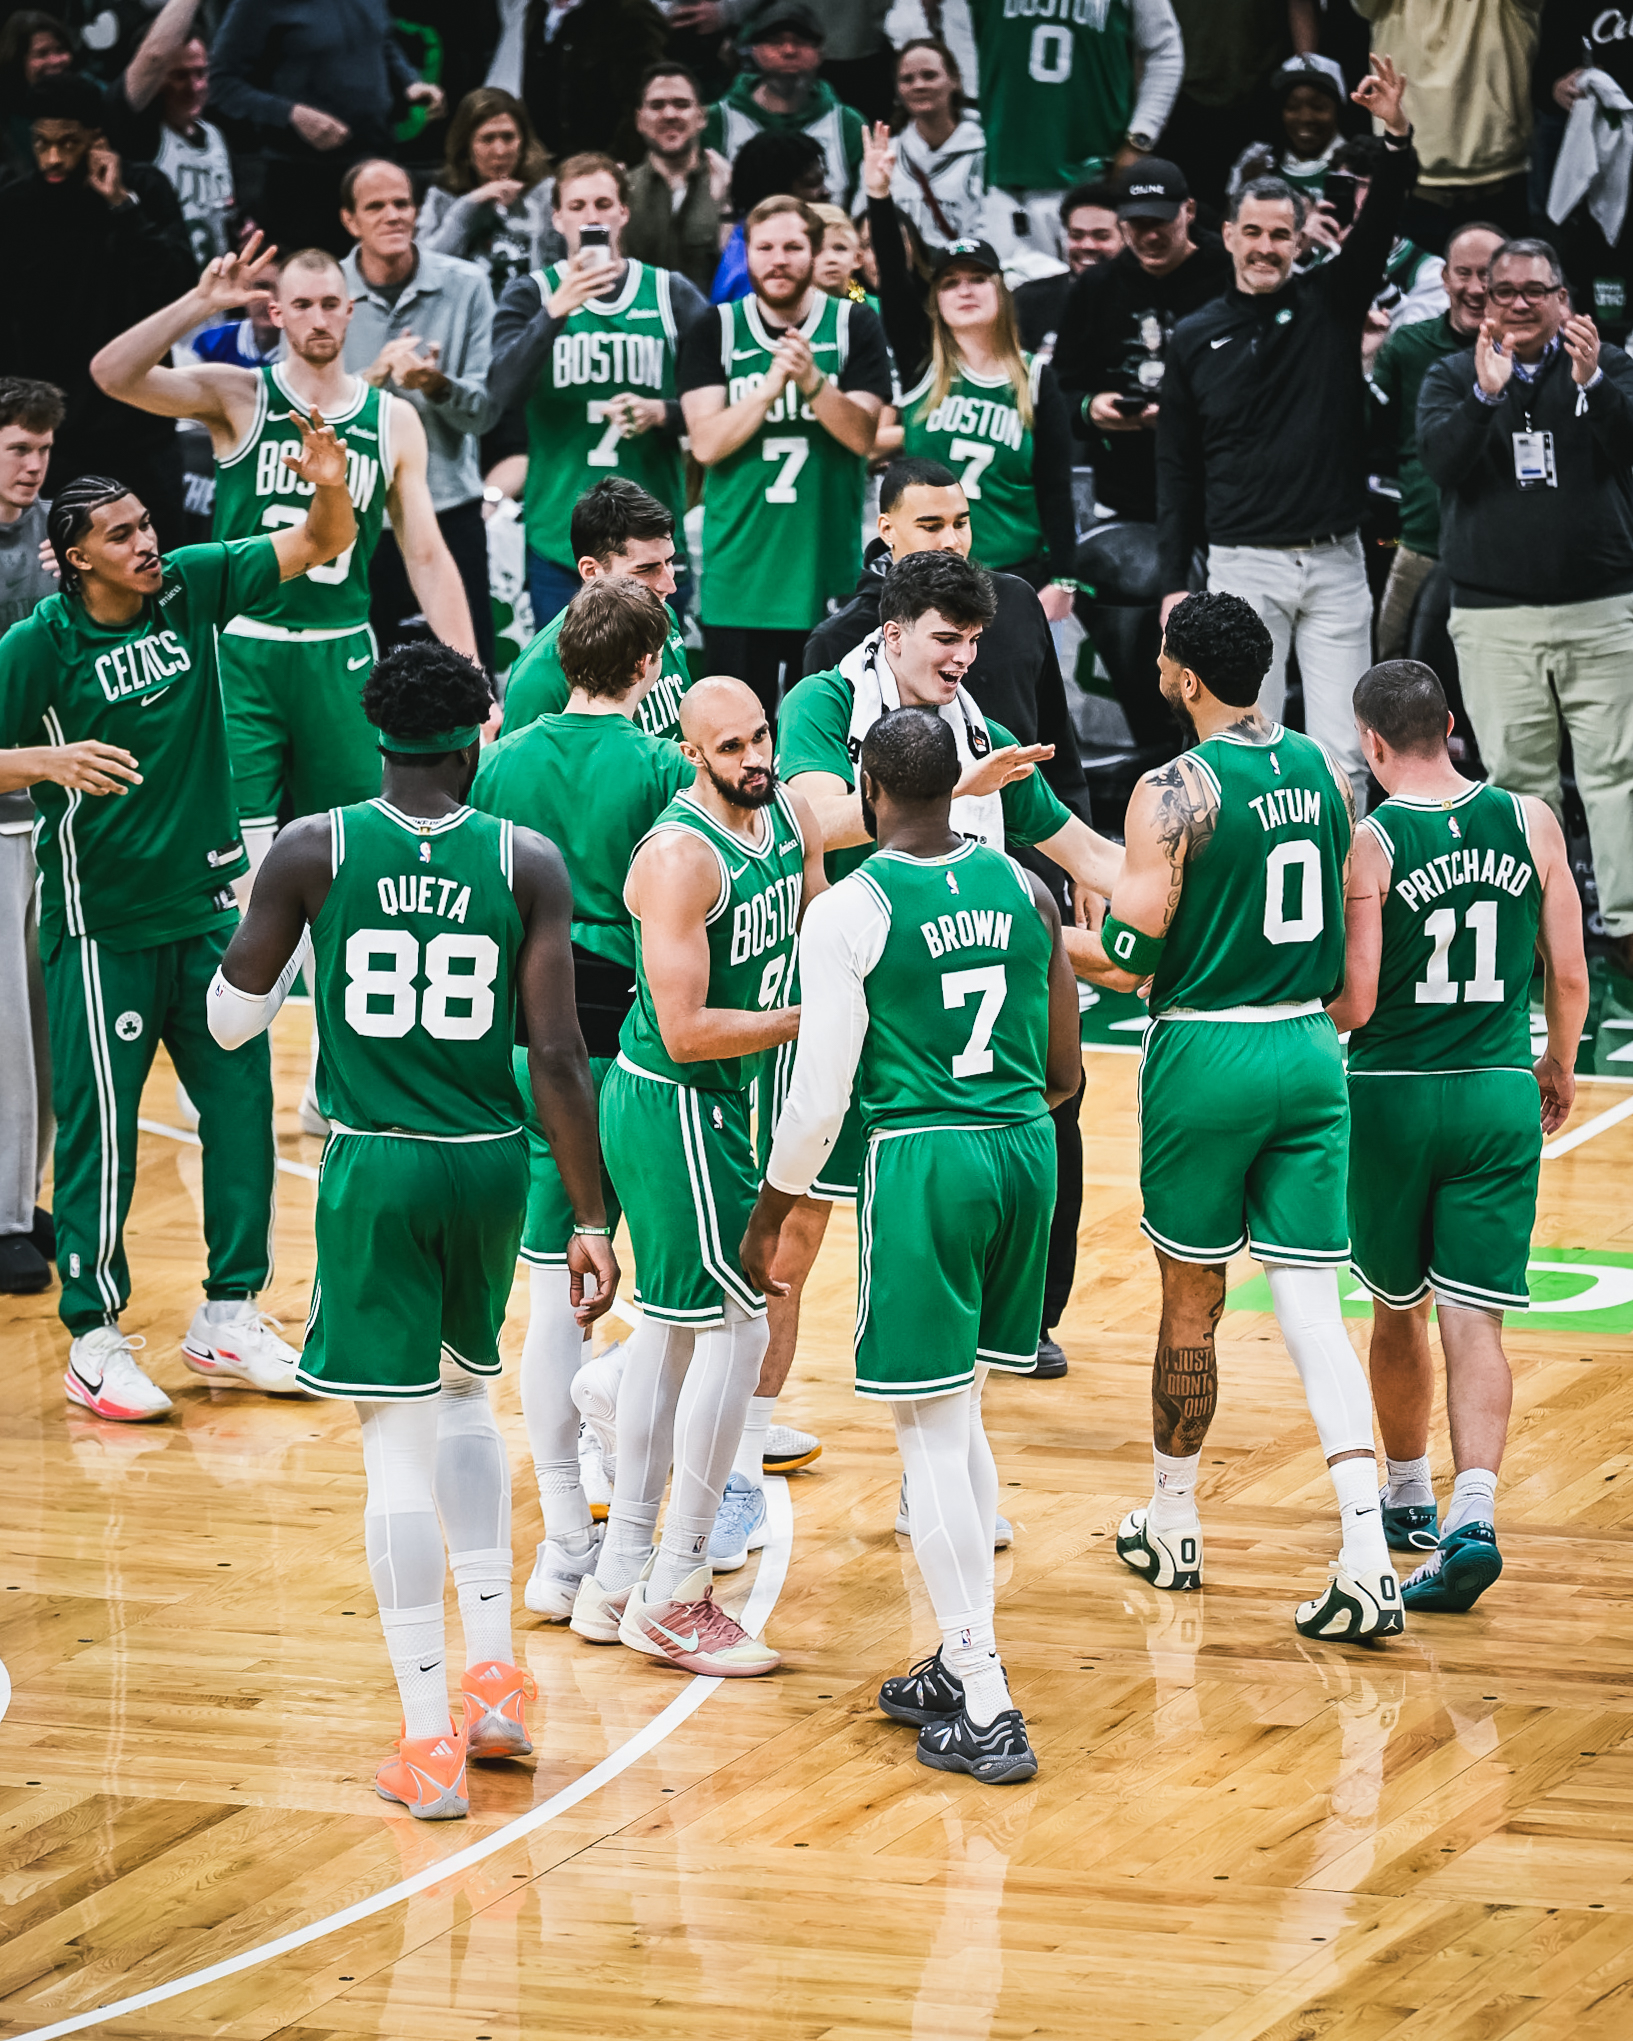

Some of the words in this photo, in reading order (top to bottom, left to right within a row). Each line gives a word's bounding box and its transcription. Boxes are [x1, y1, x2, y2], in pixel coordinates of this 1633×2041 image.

[1028, 23, 1075, 84] 0
[553, 331, 665, 390] BOSTON
[762, 436, 810, 504] 7
[949, 437, 996, 500] 7
[1248, 787, 1321, 832] TATUM
[377, 874, 472, 925] QUETA
[1263, 838, 1324, 946] 0
[1395, 848, 1533, 913] PRITCHARD
[919, 909, 1014, 960] BROWN
[1113, 930, 1137, 960] 0
[1414, 900, 1505, 1005] 11
[344, 928, 500, 1041] 88
[940, 963, 1008, 1079] 7
[1173, 1348, 1211, 1373] JUST
[1181, 1538, 1196, 1564] 0
[1379, 1575, 1396, 1601] 0
